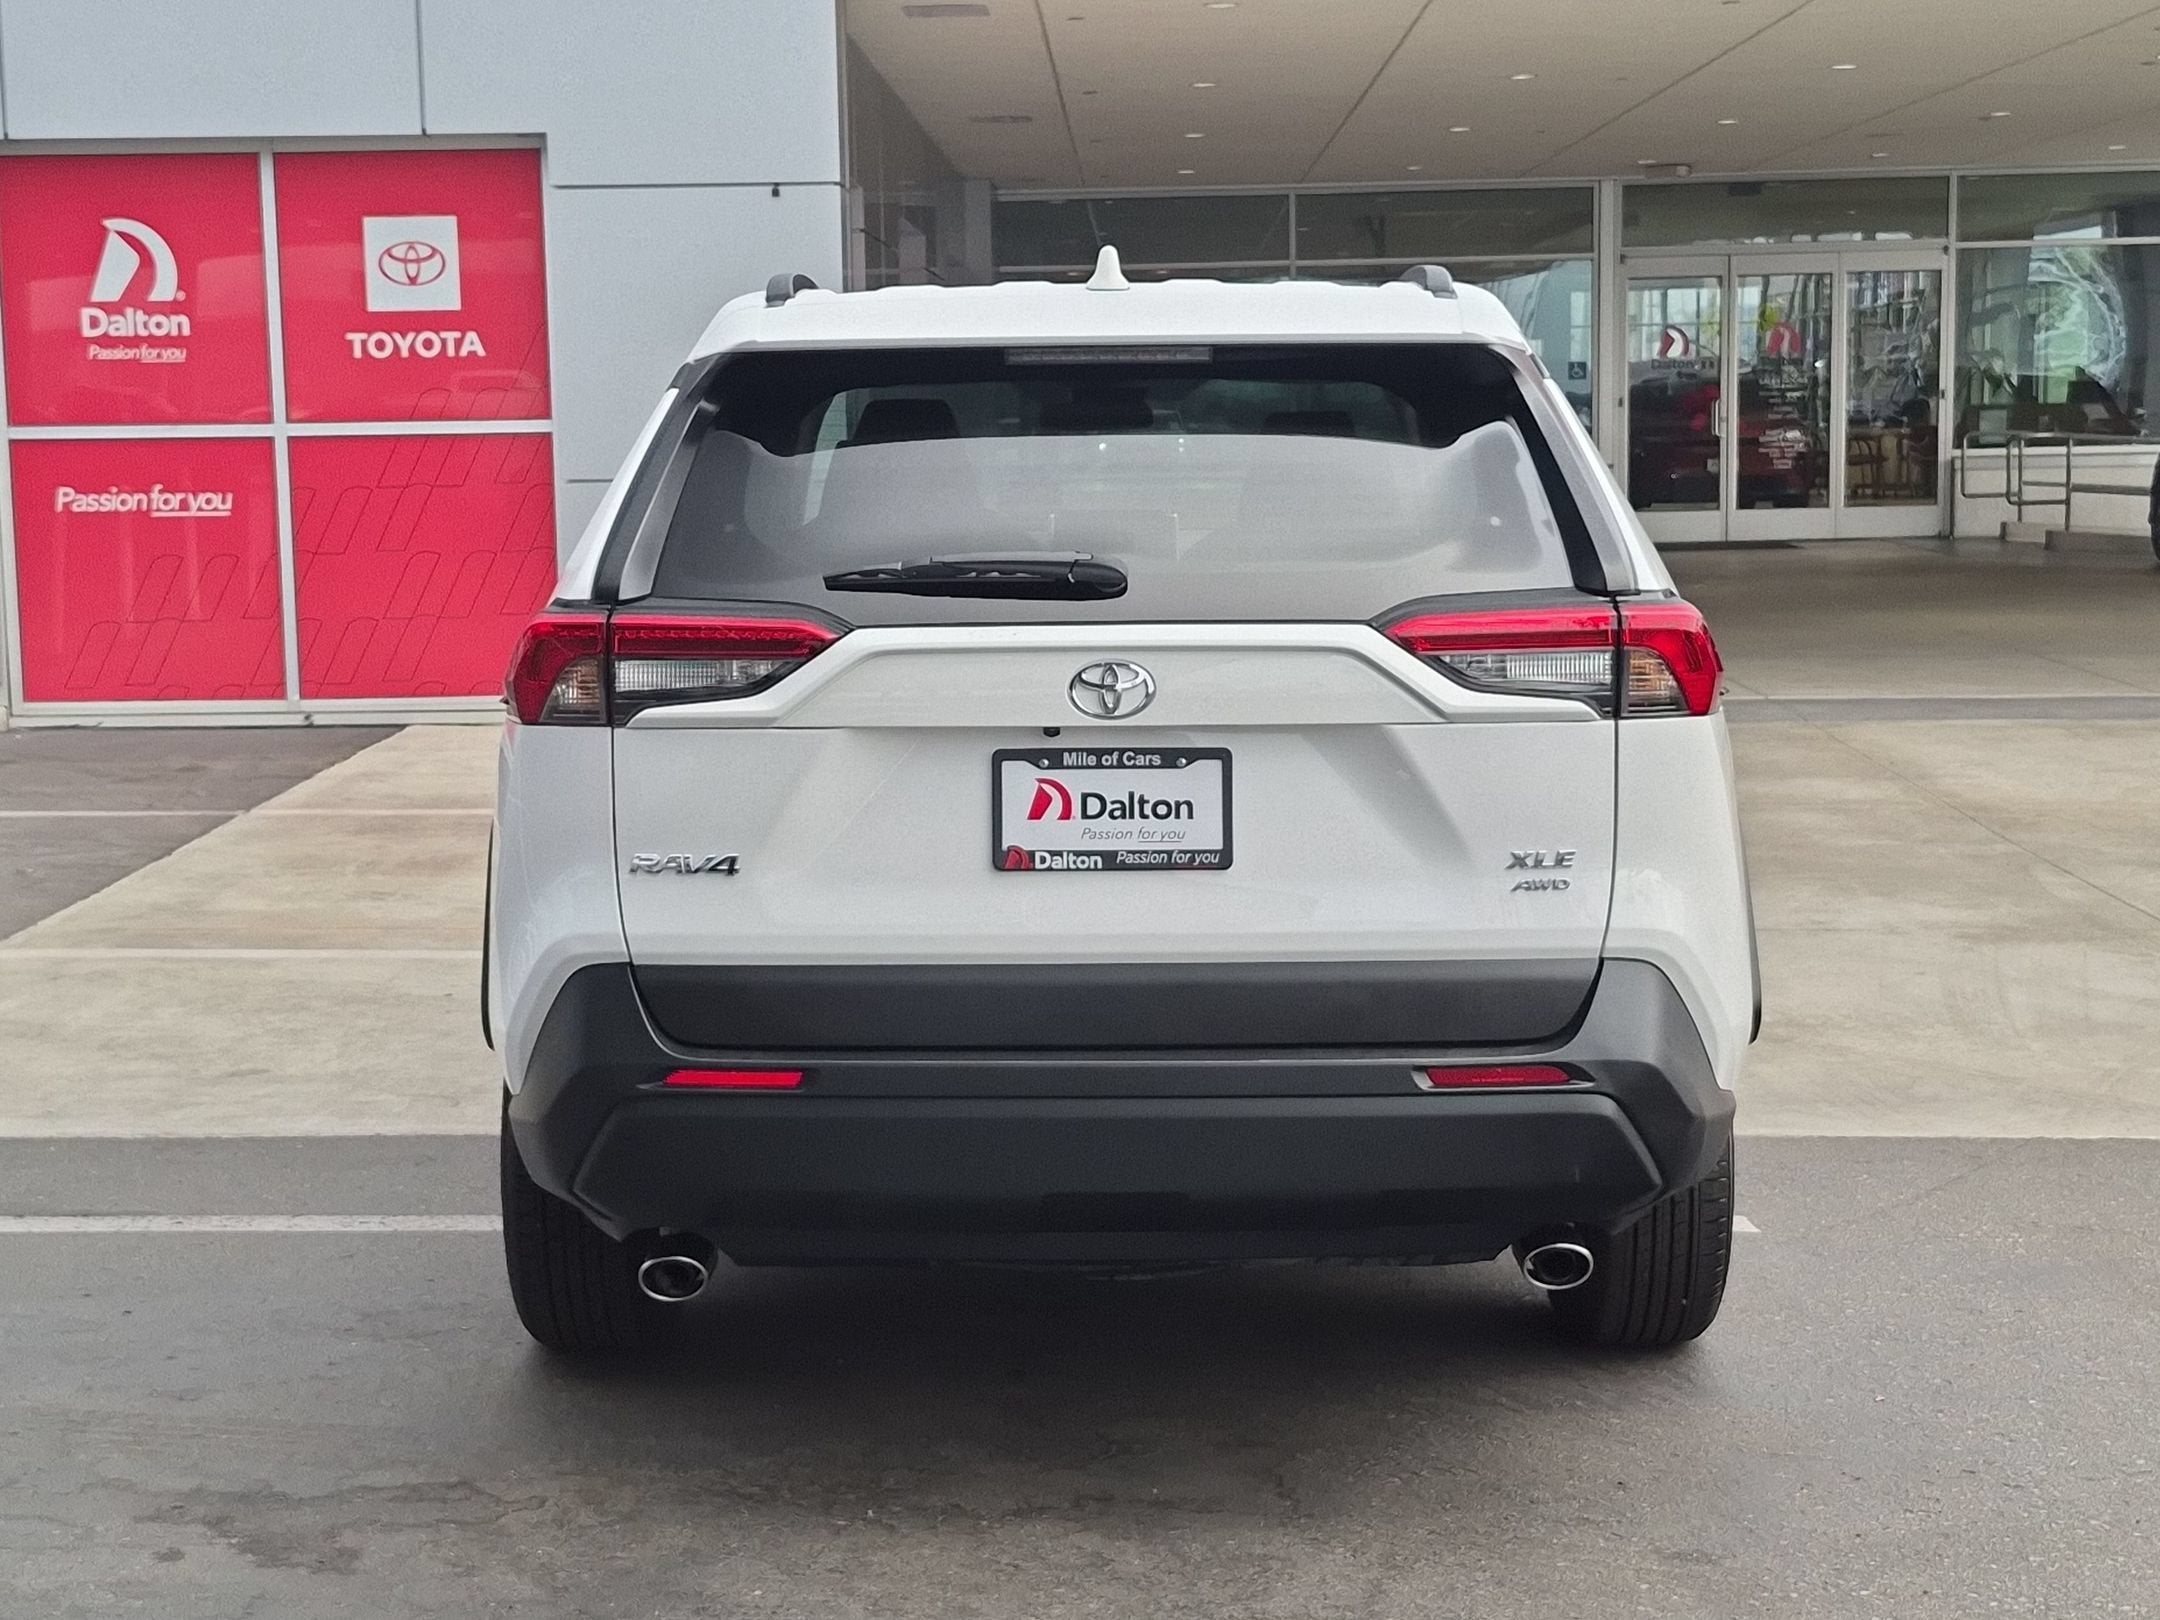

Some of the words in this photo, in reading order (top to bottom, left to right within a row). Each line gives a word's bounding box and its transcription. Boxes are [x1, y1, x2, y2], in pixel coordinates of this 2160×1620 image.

[81, 306, 191, 337] Dalton
[88, 343, 139, 360] Passion
[140, 343, 160, 361] for
[161, 347, 187, 361] you
[344, 330, 487, 359] TOYOTA
[54, 486, 148, 513] Passion
[150, 483, 186, 512] for
[187, 491, 233, 515] you
[1063, 751, 1097, 766] Mile
[1101, 751, 1119, 766] of
[1122, 751, 1161, 766] Cars
[1080, 790, 1194, 820] Dalton
[1081, 827, 1133, 840] Passion
[1137, 826, 1158, 840] for
[1160, 830, 1186, 842] you
[629, 852, 741, 877] RAV4
[1034, 851, 1103, 869] Dalton
[1116, 851, 1168, 864] Passion
[1170, 850, 1191, 864] for
[1193, 852, 1220, 866] you
[1504, 848, 1577, 870] XLE
[1510, 878, 1571, 893] AWD
